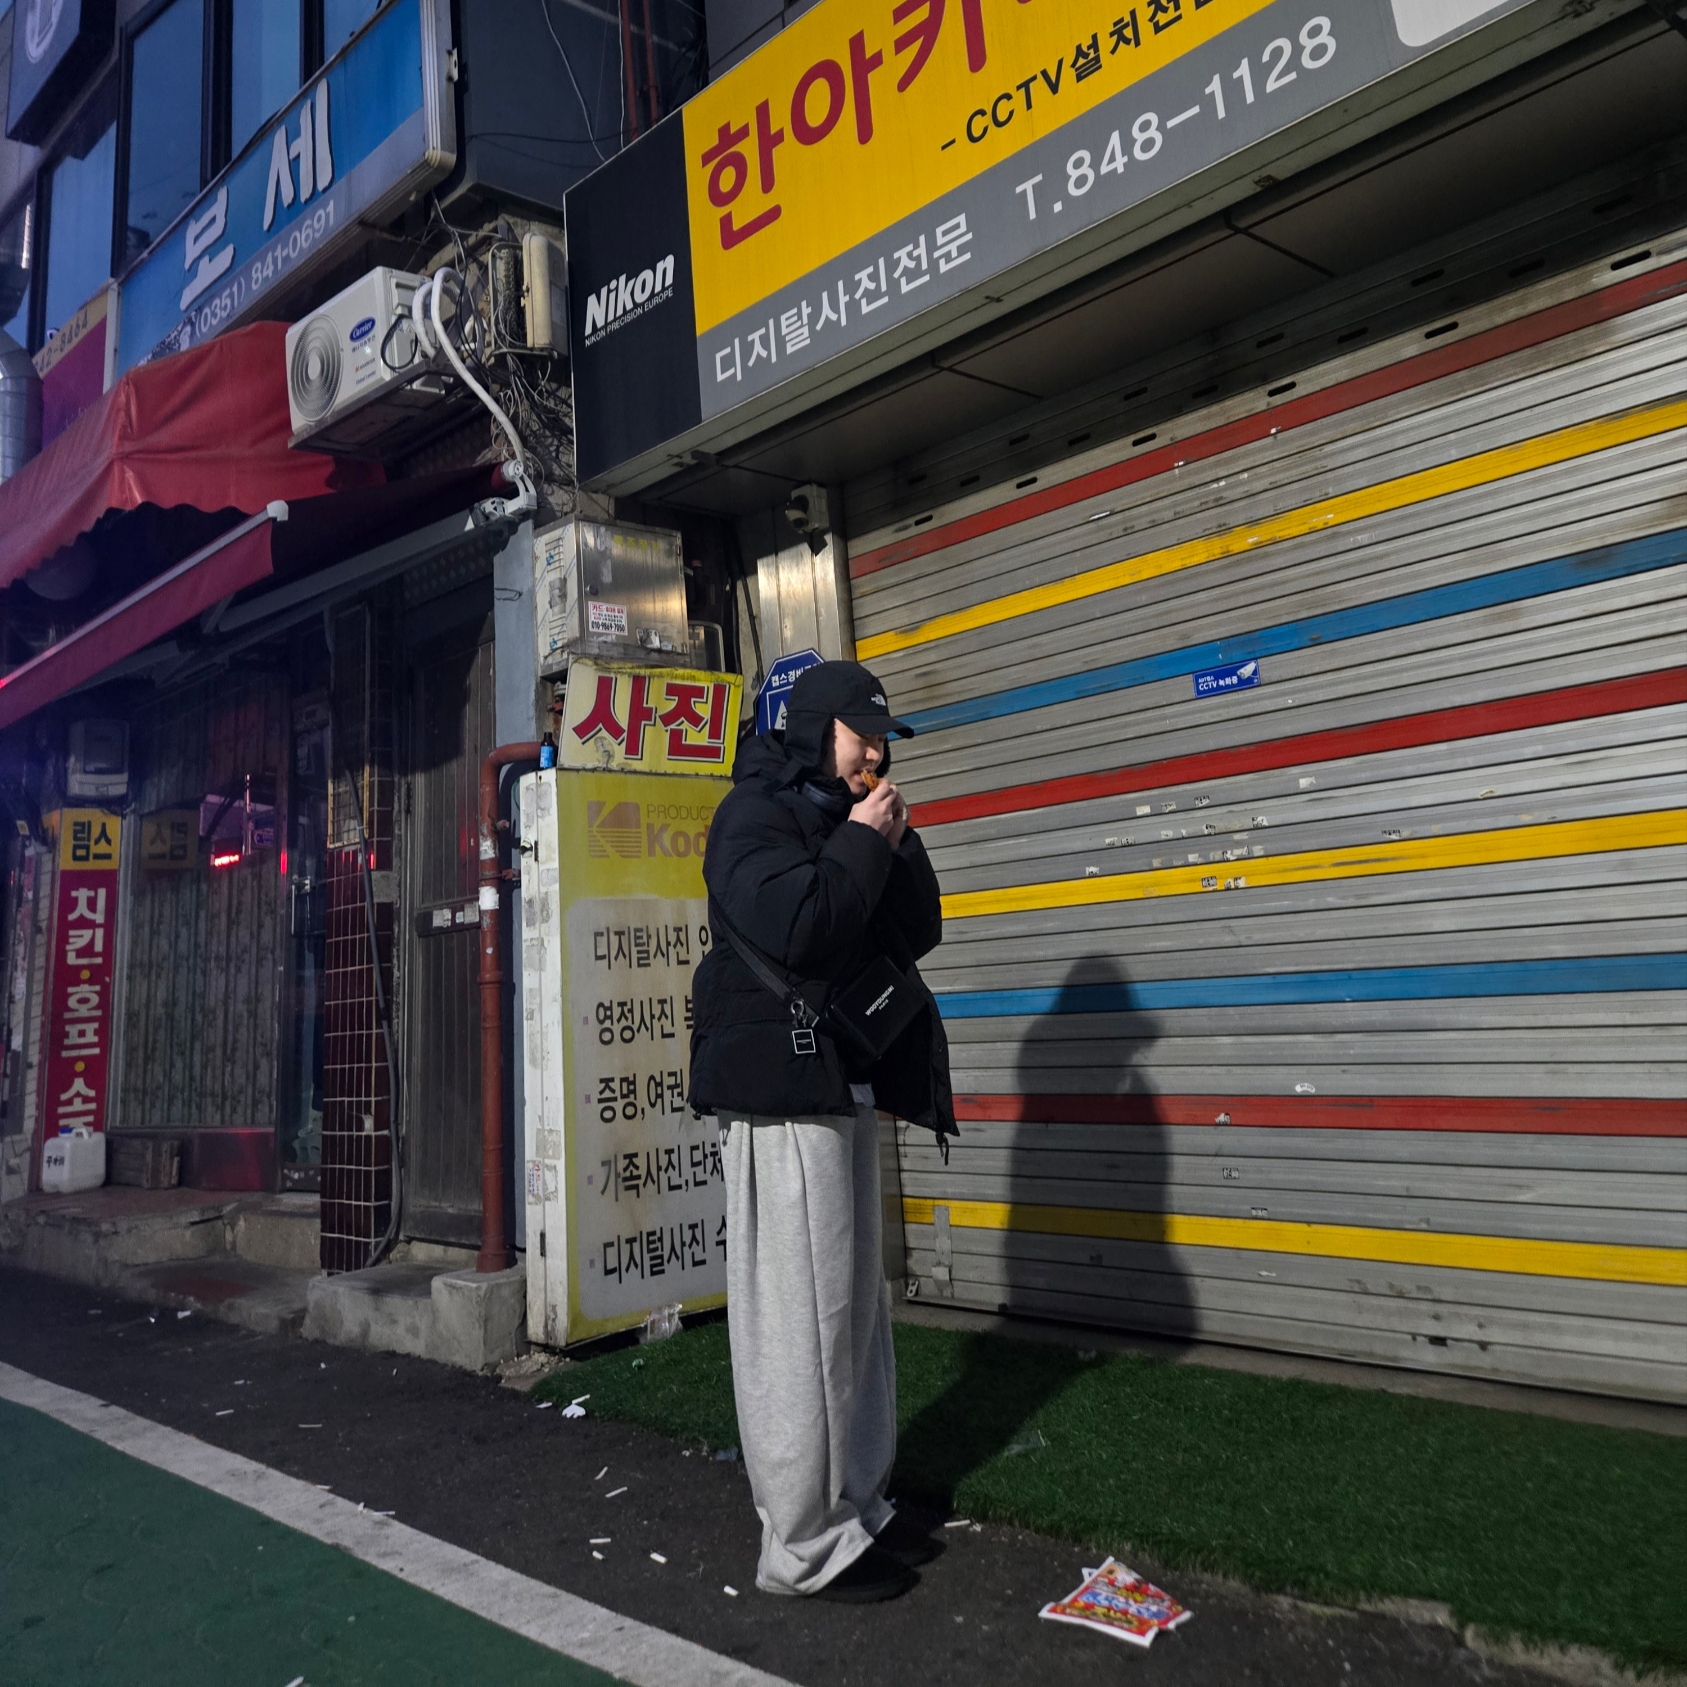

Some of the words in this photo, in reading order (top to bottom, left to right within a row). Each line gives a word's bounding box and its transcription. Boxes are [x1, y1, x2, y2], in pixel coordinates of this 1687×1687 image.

[195, 276, 246, 338] (0351)
[251, 199, 335, 291] 841-0691
[584, 253, 675, 337] Nikon
[715, 213, 974, 383] 디지탈사진전문
[352, 319, 374, 339] Carrier
[584, 327, 606, 348] NIKON
[606, 305, 643, 335] PRECISION
[644, 286, 674, 313] EUROPE
[1198, 680, 1218, 691] CCTV
[1218, 676, 1238, 686] 녹화중
[572, 674, 731, 763] 사진
[71, 820, 113, 862] 림스
[593, 924, 690, 970] 디지탈사진
[595, 995, 676, 1046] 영정사진
[603, 1218, 707, 1285] 디지털사진
